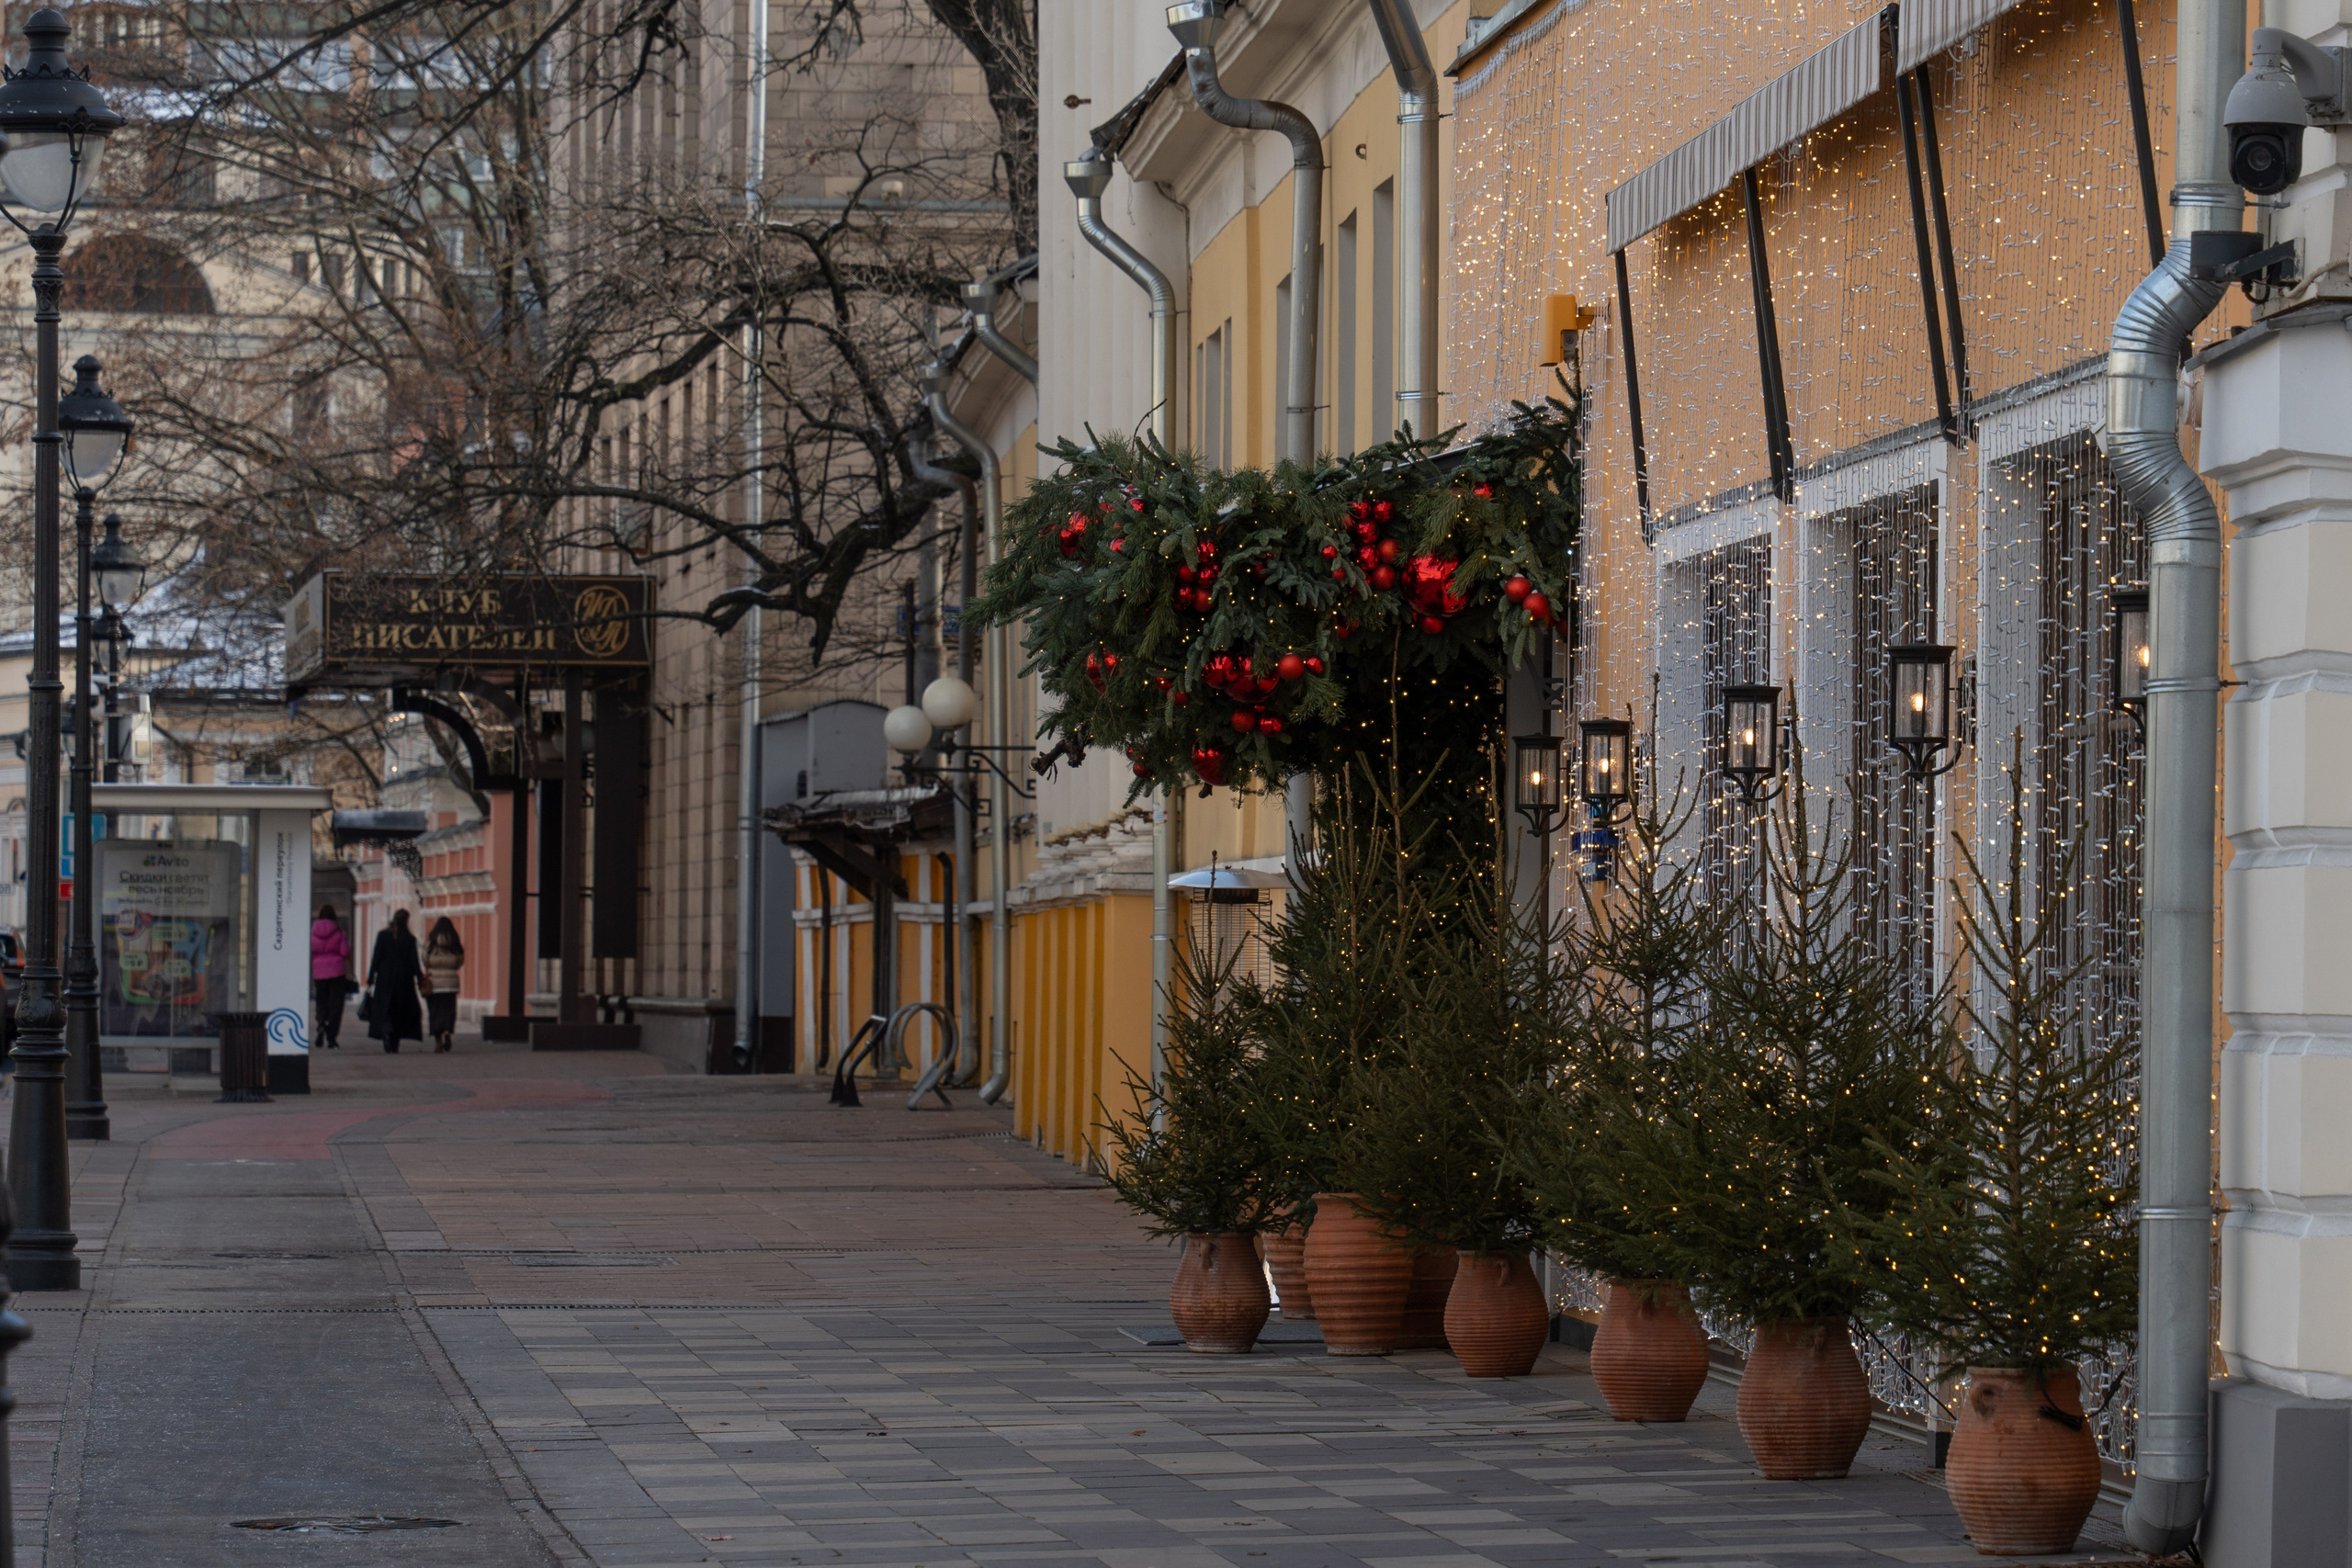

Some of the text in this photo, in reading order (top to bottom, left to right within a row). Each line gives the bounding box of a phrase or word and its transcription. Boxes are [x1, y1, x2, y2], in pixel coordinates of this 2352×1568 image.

[409, 589, 502, 615] КЛУБ
[352, 620, 557, 650] ПИСАТЕЛЕЙ
[119, 870, 166, 882] Скидки
